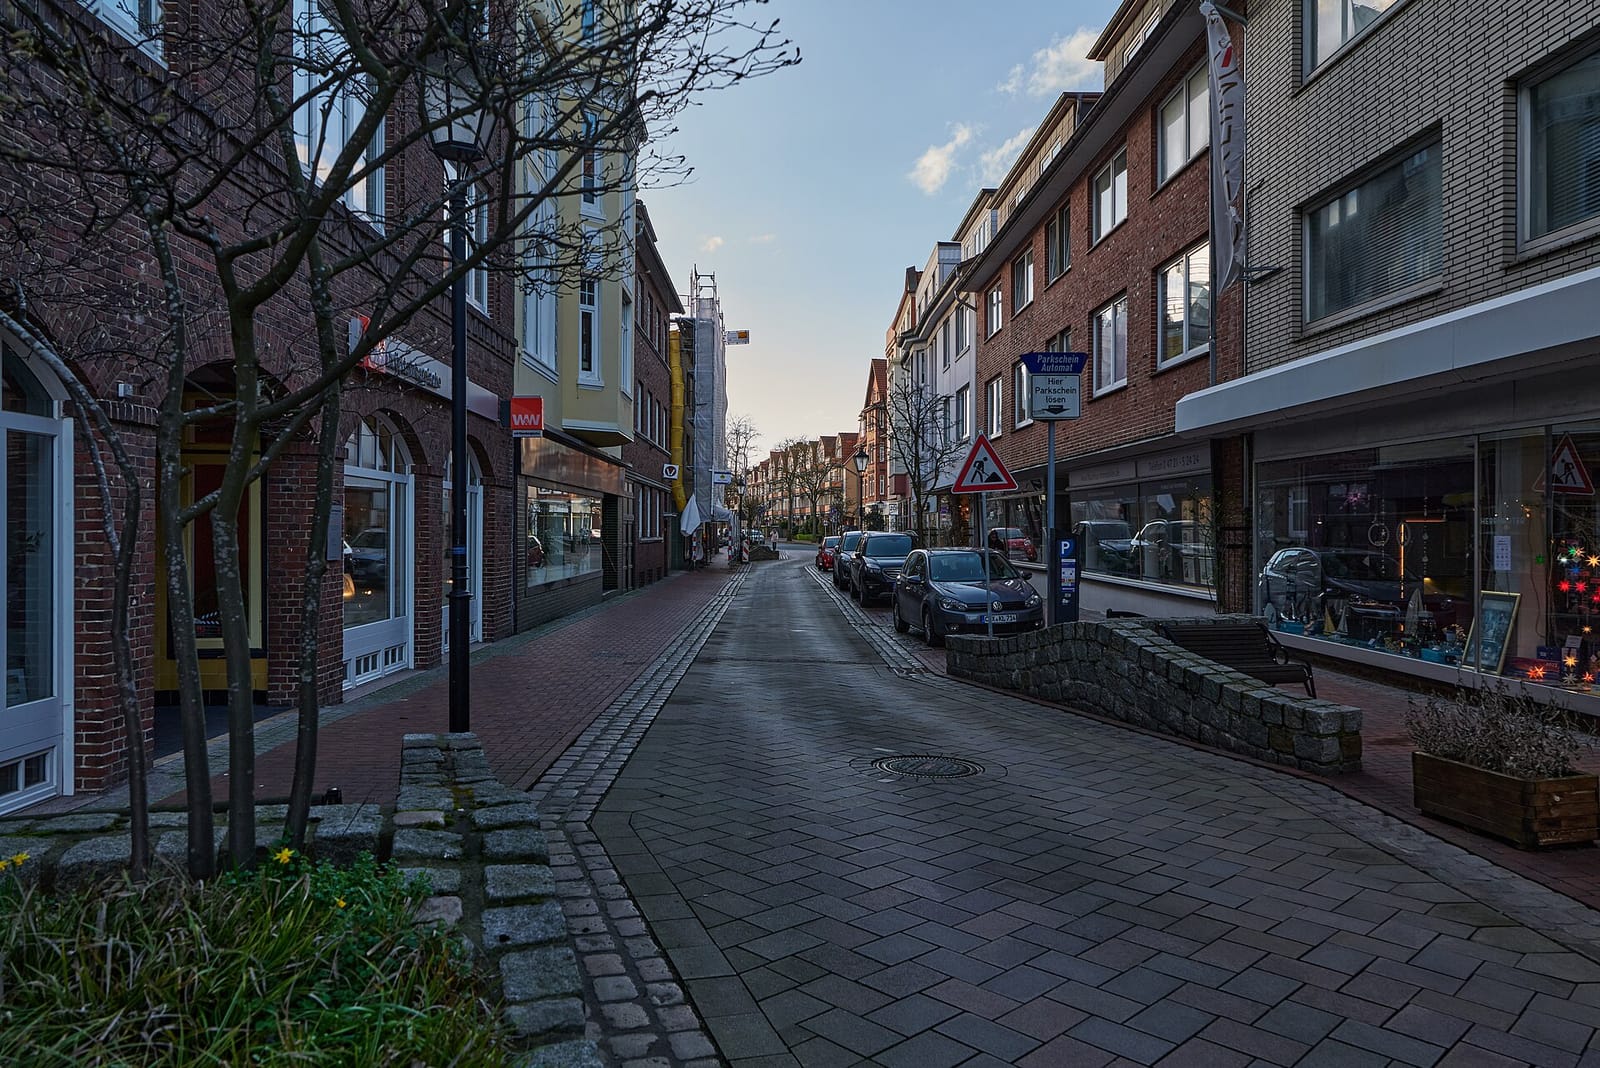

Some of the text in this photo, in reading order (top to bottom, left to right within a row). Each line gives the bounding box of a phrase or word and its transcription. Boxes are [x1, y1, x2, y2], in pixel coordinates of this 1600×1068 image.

[1037, 354, 1080, 364] Parkschein
[1041, 363, 1073, 372] Automat
[1048, 377, 1064, 385] Hier
[1035, 386, 1077, 395] Parkschein
[1046, 395, 1066, 404] lösen
[1060, 541, 1071, 555] P
